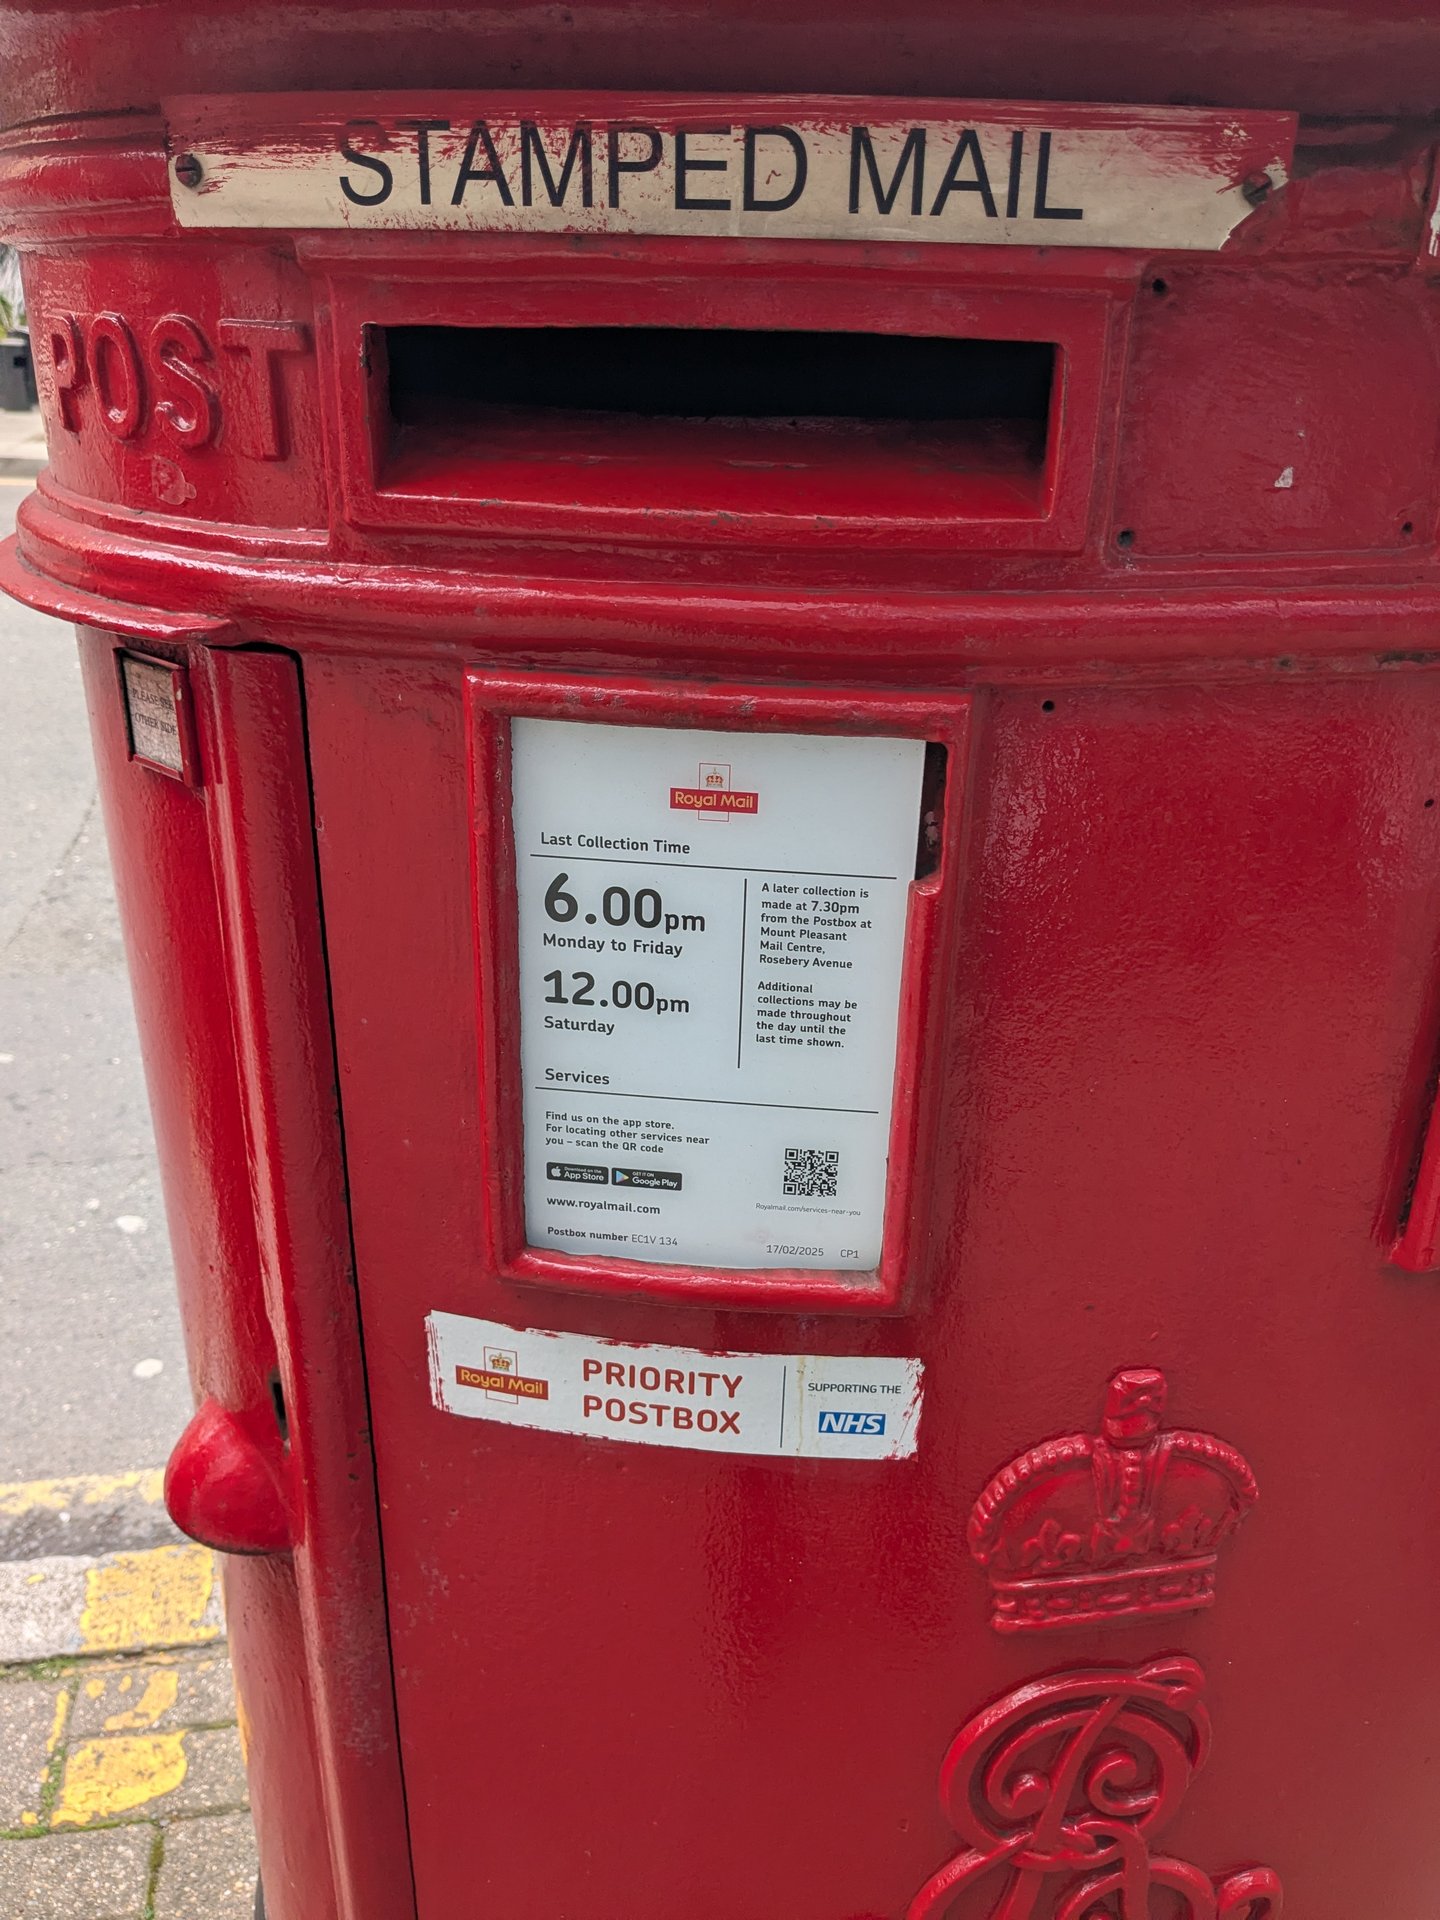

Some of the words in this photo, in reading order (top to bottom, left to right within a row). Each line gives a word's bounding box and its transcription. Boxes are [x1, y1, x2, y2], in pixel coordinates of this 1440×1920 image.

[339, 119, 809, 213] STAMPED
[848, 127, 1084, 219] MAIL
[44, 310, 309, 461] POST
[132, 688, 159, 706] PLEASE
[135, 713, 159, 730] OTHER
[161, 721, 177, 736] SIDE
[675, 792, 716, 808] Royal
[720, 795, 753, 808] Mail
[541, 832, 572, 846] Last
[578, 835, 649, 851] Collection
[653, 840, 690, 854] Time
[762, 883, 769, 892] A
[773, 884, 799, 894] later
[803, 886, 856, 897] collection
[860, 889, 869, 898] is
[545, 873, 706, 934] 6.00pm
[762, 901, 792, 910] made
[796, 903, 807, 911] at
[811, 901, 860, 915] 7.30pm
[761, 913, 787, 923] from
[792, 915, 809, 925] the
[814, 916, 857, 928] Postbox
[860, 920, 872, 929] at
[761, 927, 795, 938] Mount
[800, 930, 847, 941] Pleasant
[544, 933, 605, 953] Monday
[611, 940, 626, 951] to
[634, 940, 683, 958] Friday
[760, 941, 782, 951] Mail
[787, 942, 825, 954] Centre,
[760, 955, 809, 968] Rosebery
[813, 958, 853, 969] Avenue
[544, 970, 689, 1015] 12.00pm
[758, 981, 813, 993] Additional
[758, 996, 814, 1006] collections
[819, 1000, 841, 1010] may
[845, 1000, 857, 1009] be
[757, 1009, 786, 1018] made
[790, 1010, 851, 1022] throughout
[544, 1016, 615, 1035] Saturday
[756, 1022, 774, 1030] the
[778, 1023, 796, 1033] day
[801, 1025, 824, 1034] until
[829, 1026, 846, 1035] the
[756, 1034, 775, 1043] last
[779, 1036, 803, 1045] time
[807, 1038, 844, 1048] shown.
[545, 1068, 610, 1085] Services
[546, 1111, 567, 1121] Find
[572, 1114, 583, 1123] us
[586, 1115, 599, 1124] on
[602, 1116, 619, 1125] the
[623, 1119, 641, 1129] app
[645, 1120, 675, 1130] store.
[546, 1124, 562, 1133] For
[566, 1125, 606, 1138] locating
[610, 1130, 638, 1139] other
[641, 1132, 682, 1143] services
[686, 1135, 710, 1145] near
[546, 1137, 564, 1146] you
[576, 1139, 599, 1148] scan
[602, 1140, 619, 1149] the
[622, 1142, 636, 1151] QR
[641, 1144, 664, 1153] code
[564, 1171, 580, 1180] App
[582, 1173, 604, 1181] Store
[632, 1177, 660, 1187] Google
[662, 1179, 677, 1189] Play
[547, 1198, 660, 1215] www.royalmail.com
[756, 1203, 861, 1216] Royalmail.com/services-near-you
[548, 1227, 586, 1238] Postbox
[590, 1232, 628, 1242] number
[632, 1235, 656, 1244] EC1V
[660, 1237, 678, 1246] 134
[766, 1245, 824, 1256] 17/02/2025
[840, 1249, 859, 1258] CP1
[461, 1369, 505, 1390] Royal
[508, 1378, 543, 1395] Mail
[583, 1359, 743, 1398] PRIORITY
[808, 1382, 878, 1395] SUPPORTING
[880, 1384, 902, 1395] THE
[584, 1394, 741, 1435] POSTBOX
[824, 1414, 883, 1434] NHS
